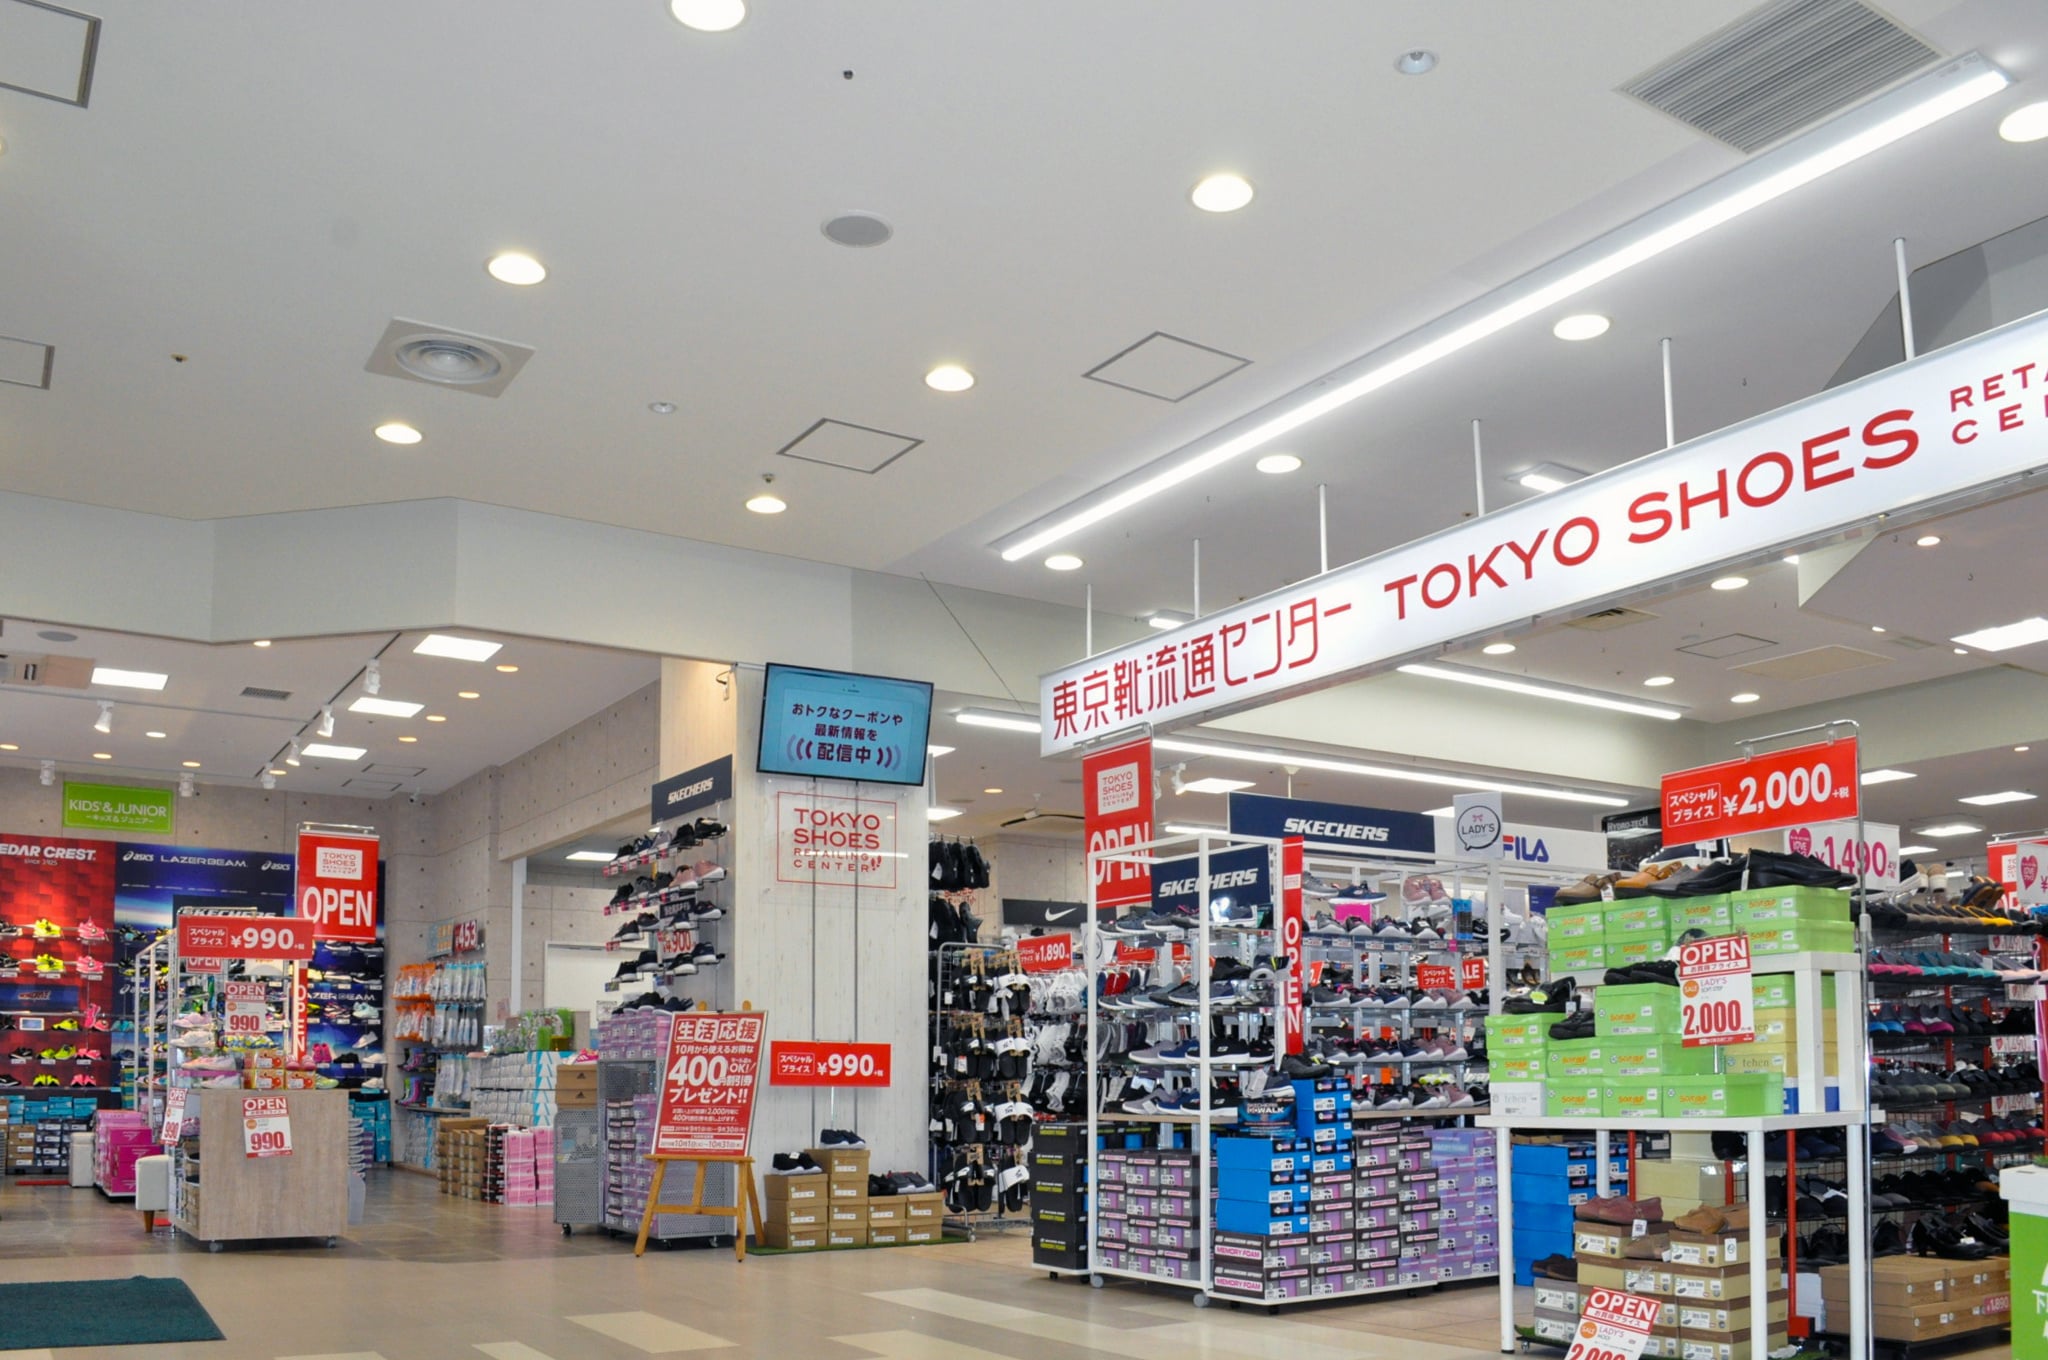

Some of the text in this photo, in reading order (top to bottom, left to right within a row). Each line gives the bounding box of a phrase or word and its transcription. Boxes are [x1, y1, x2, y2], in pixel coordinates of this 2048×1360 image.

[1949, 363, 2048, 413] RET
[1952, 394, 2048, 445] CE
[1384, 409, 1920, 620] TOKYO SHOES
[1053, 597, 1352, 740] 東京靴流通センター
[792, 703, 903, 726] おトクなクーポンや
[815, 724, 878, 741] 最新情報を
[817, 743, 871, 764] 配信中
[1102, 771, 1133, 785] TOKYO
[668, 777, 714, 805] SKECHERS
[1102, 781, 1133, 796] SHOES
[1669, 763, 1849, 816] スペシャル ¥2,000 +税
[69, 799, 167, 818] KIDS & JUNIOR
[1672, 804, 1715, 823] プライス
[793, 808, 880, 831] TOKYO
[1283, 817, 1390, 842] SKECHERS
[1461, 822, 1495, 836] LADY'S
[793, 827, 880, 850] SHOES
[1502, 834, 1550, 863] FILA
[43, 846, 97, 861] CREST
[160, 855, 249, 868] LAZERBEAM
[322, 858, 357, 868] SHOES
[323, 851, 357, 861] TOKYO
[793, 848, 870, 862] RETAILING
[1090, 822, 1150, 886] OPEN
[793, 859, 869, 873] CENTER
[302, 886, 373, 928] OPEN
[189, 927, 226, 937] スペシャル
[231, 927, 295, 950] ¥990
[190, 937, 224, 946] プライス
[1682, 938, 1747, 966] OPEN
[226, 984, 266, 996] OPEN
[230, 1014, 260, 1031] 990
[1683, 999, 1741, 1036] 2,000
[677, 1020, 758, 1041] 生活応援
[667, 1055, 729, 1087] 400
[780, 1054, 813, 1063] スペシャル
[817, 1053, 875, 1077] ¥990
[781, 1064, 811, 1073] プライス
[244, 1098, 287, 1111] OPEN
[669, 1086, 748, 1105] プレゼント!!
[251, 1131, 285, 1151] 990
[1216, 1246, 1261, 1259] MEMORY FOAM
[1216, 1277, 1262, 1290] MEMORY FOAM
[1590, 1290, 1657, 1321] OPEN
